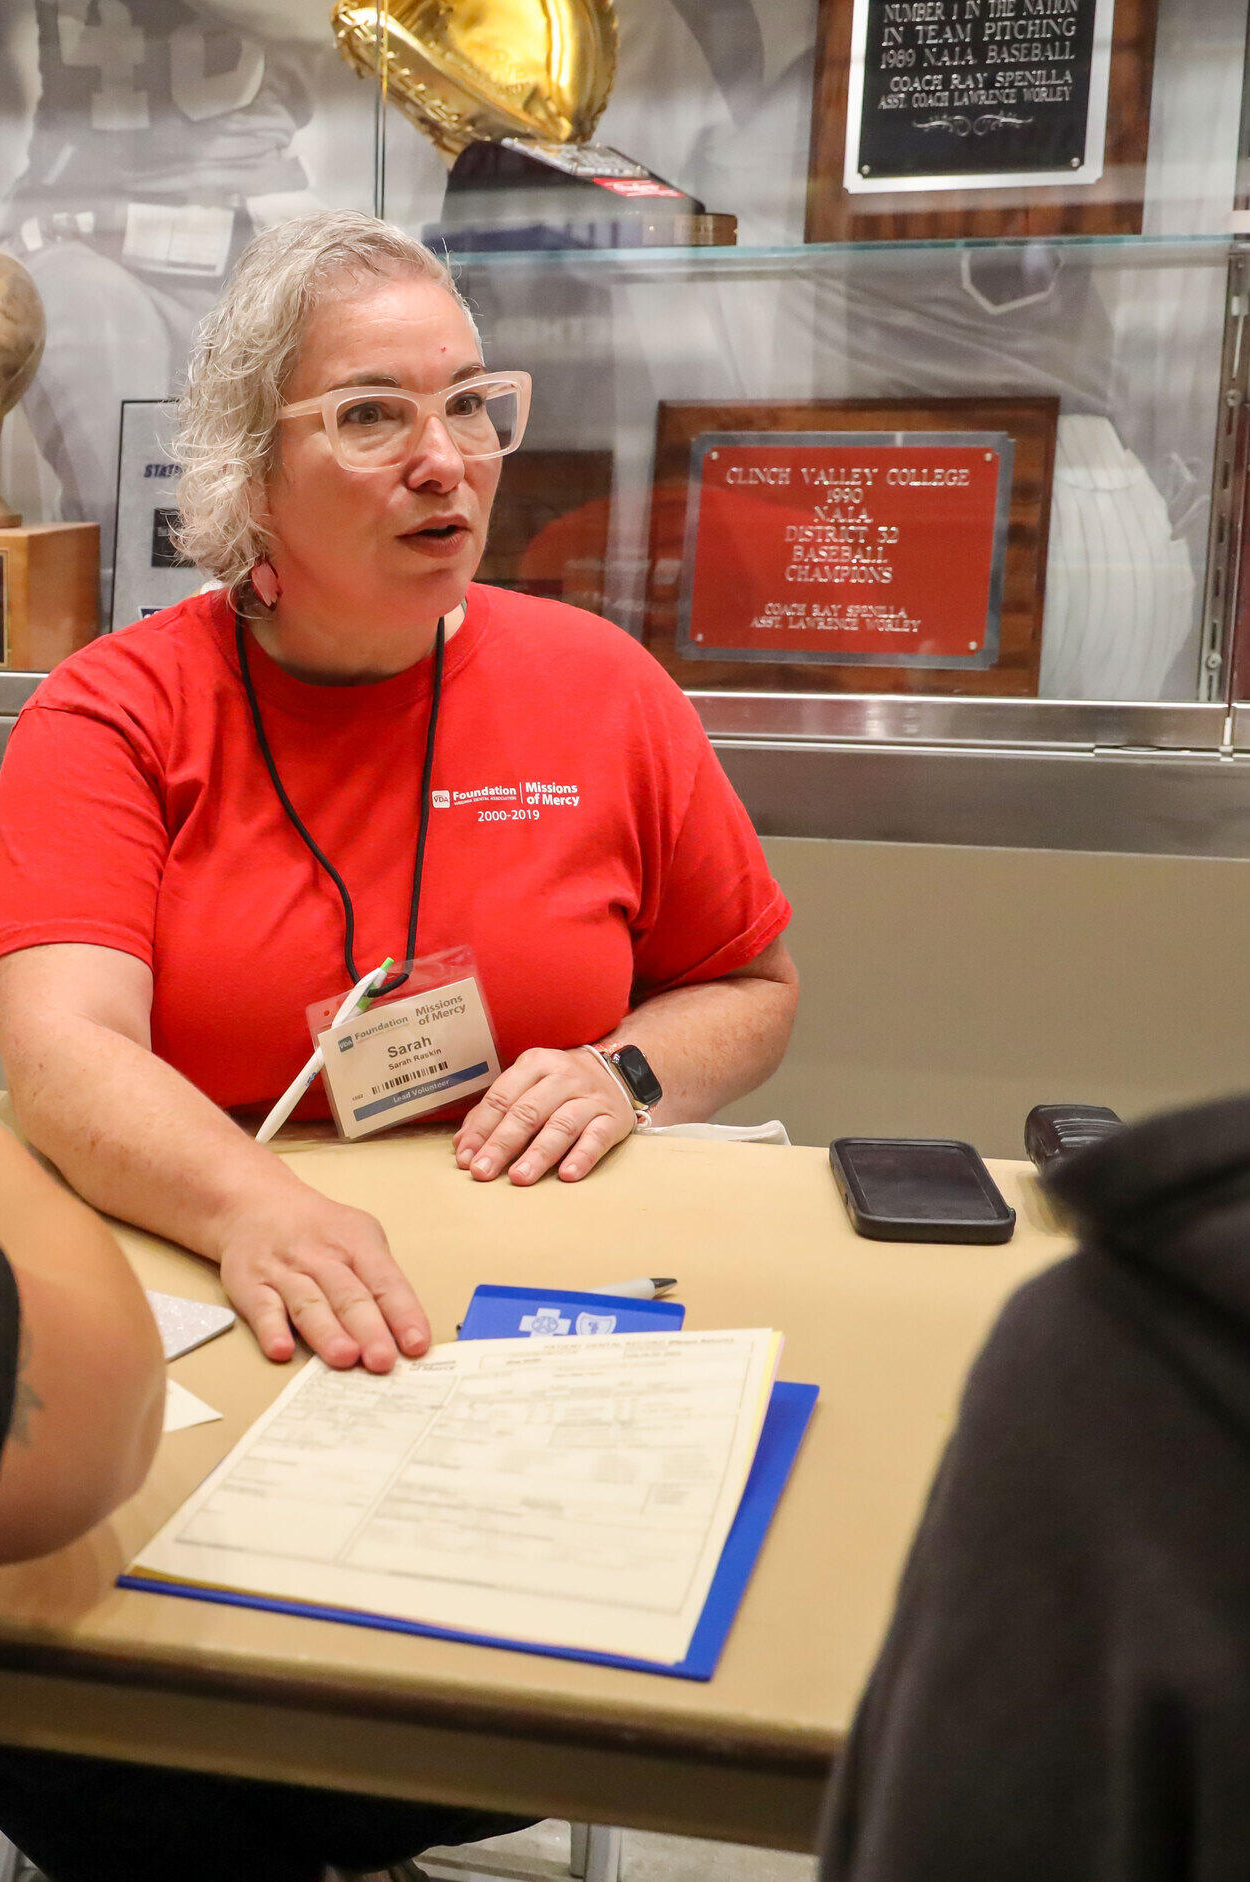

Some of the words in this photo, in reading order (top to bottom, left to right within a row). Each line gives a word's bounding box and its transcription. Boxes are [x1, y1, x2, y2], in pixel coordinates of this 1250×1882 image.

[883, 2, 946, 23] NUMBER
[964, 0, 981, 19] IN
[988, 0, 1016, 18] THE
[1022, 0, 1078, 15] NATION
[881, 26, 904, 47] IN
[915, 23, 972, 44] TEAM
[982, 17, 1077, 41] PITCHING
[880, 48, 917, 69] 1989
[985, 41, 1076, 64] BASEBALL
[889, 74, 944, 92] COACH
[950, 72, 988, 89] RAY
[994, 69, 1073, 87] SPENILLA
[911, 91, 949, 108] COACH
[953, 88, 1017, 106] LAWRENCE
[1022, 86, 1073, 103] WORLEY
[726, 467, 792, 485] CLINCH
[800, 467, 879, 486] VALLEY
[886, 468, 971, 486] COLLEGE
[827, 487, 864, 504] 1990
[784, 525, 869, 543] DISTRICT
[792, 545, 888, 564] BASEBALL
[784, 565, 894, 583] CHAMPIONS
[764, 602, 807, 617] COACH
[811, 603, 842, 617] RAY
[788, 617, 859, 631] LAWRENCE
[452, 786, 517, 801] Foundation
[525, 782, 578, 794] Missions
[526, 793, 541, 805] of
[542, 794, 580, 807] Mercy
[477, 809, 540, 822] 2000-2019
[415, 995, 463, 1017] Missions
[418, 1014, 430, 1026] of
[431, 1004, 466, 1021] Mercy
[354, 1016, 409, 1040] Foundation
[387, 1036, 432, 1059] Sarah
[388, 1058, 413, 1071] Sarah
[413, 1048, 442, 1062] Raskin
[393, 1091, 411, 1103] Lead
[411, 1080, 450, 1097] Volunteer
